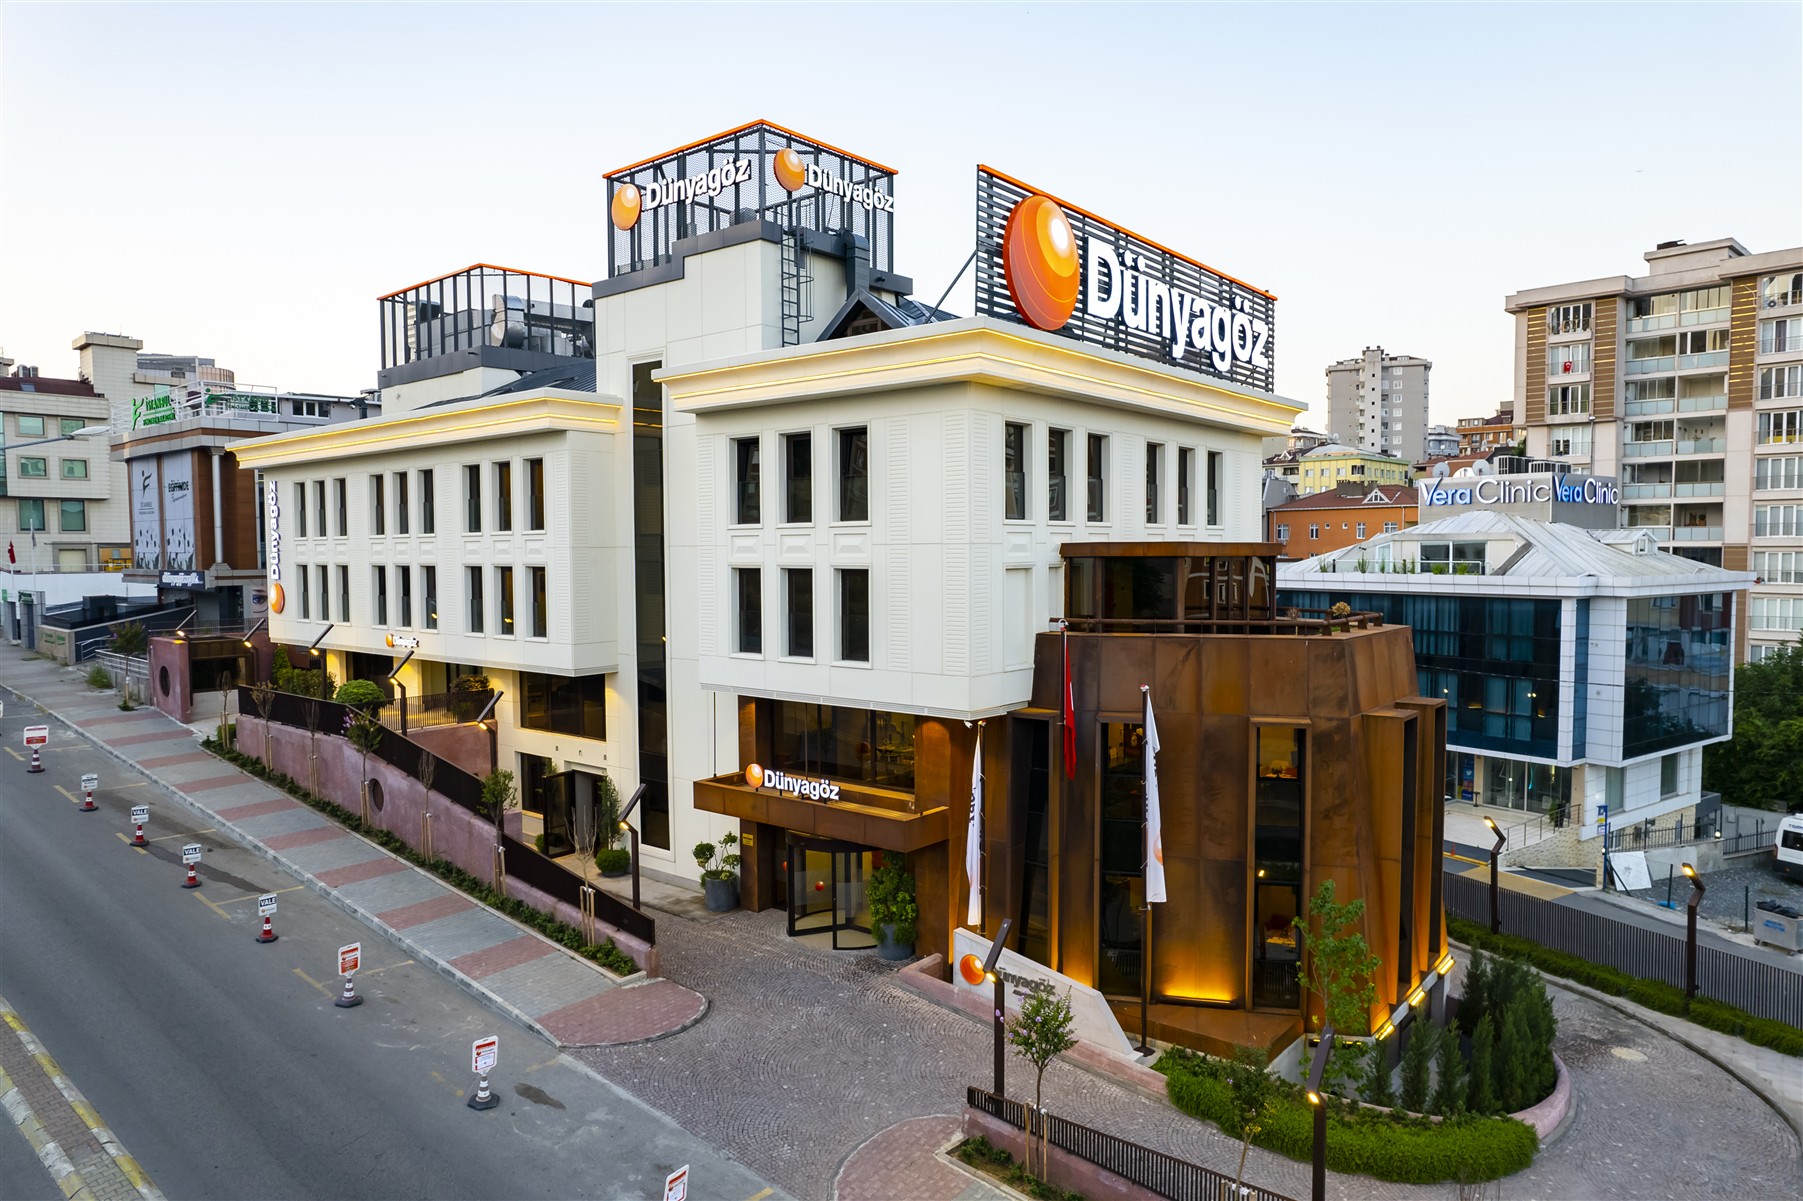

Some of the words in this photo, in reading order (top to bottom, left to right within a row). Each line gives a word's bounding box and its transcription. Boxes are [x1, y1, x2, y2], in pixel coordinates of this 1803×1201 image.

[646, 157, 751, 210] Dünyagöz
[807, 163, 894, 213] Dünyagöz
[1085, 235, 1269, 372] Dünyagöz
[1420, 475, 1472, 506] Vera
[1475, 478, 1551, 505] Clinic
[1553, 473, 1583, 503] Vera
[1584, 477, 1619, 505] Clinic
[268, 480, 281, 580] Dünyagöz
[763, 769, 840, 800] Dünyagöz
[132, 808, 148, 816] VALE
[184, 847, 201, 855] VALE
[260, 897, 276, 906] VALE
[994, 966, 1056, 997] ünyagöz
